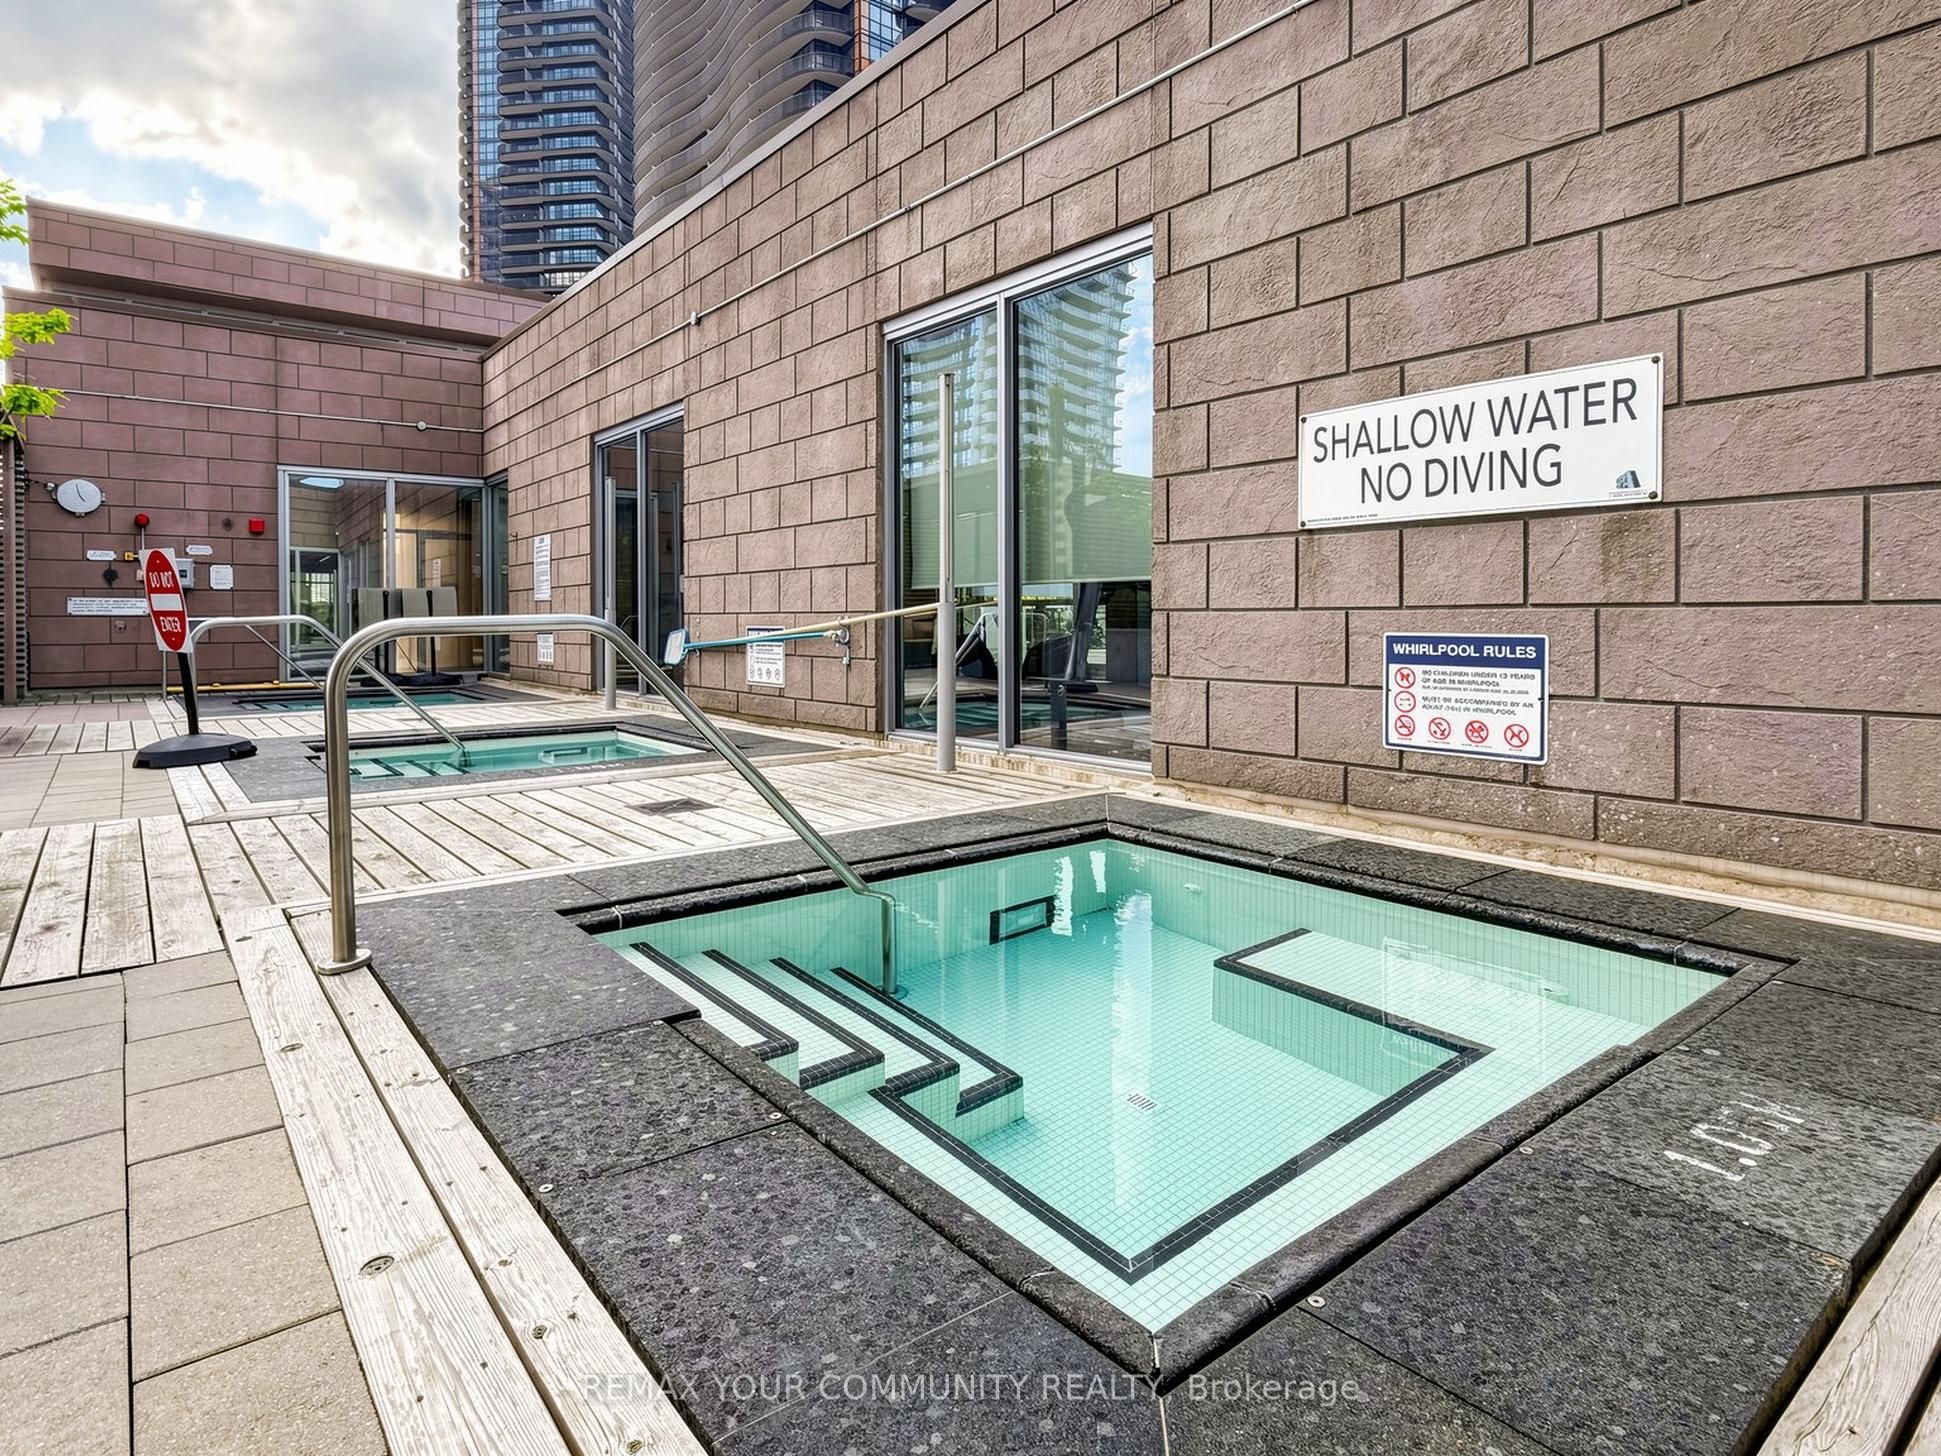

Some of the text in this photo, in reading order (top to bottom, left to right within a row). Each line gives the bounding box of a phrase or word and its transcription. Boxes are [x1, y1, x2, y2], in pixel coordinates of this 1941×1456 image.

[1313, 377, 1638, 463] SHALLOW WATER
[1361, 443, 1562, 503] NO DIVING
[149, 571, 174, 588] DO NOT
[160, 616, 182, 632] ENTER
[1392, 643, 1537, 659] WHIRLPOOL RULES
